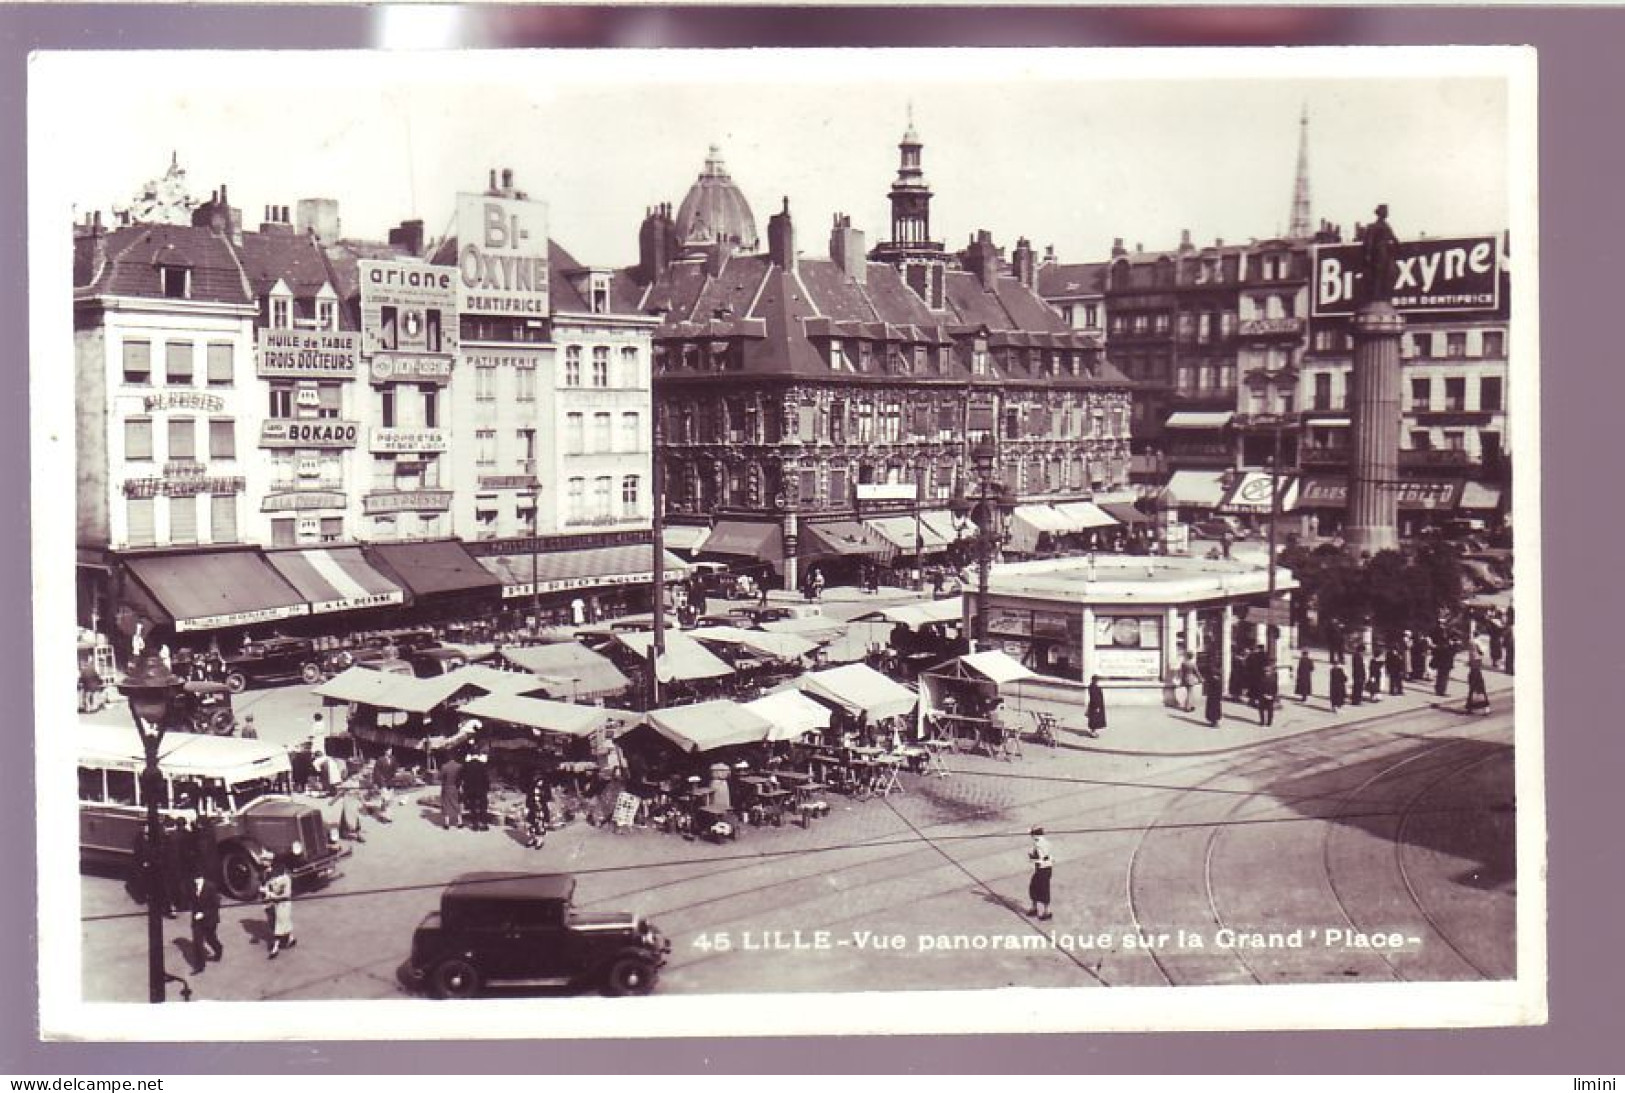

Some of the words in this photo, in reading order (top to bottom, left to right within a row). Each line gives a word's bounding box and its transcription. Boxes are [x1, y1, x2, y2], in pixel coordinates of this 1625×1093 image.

[461, 242, 548, 291] OXYNE
[370, 268, 450, 289] ariane
[466, 296, 542, 312] DENTIFRICE
[267, 336, 300, 348] HUILE
[303, 337, 318, 349] de
[321, 336, 353, 350] TABLE
[264, 351, 296, 369] TROIS
[297, 351, 354, 371] DOCTEURS
[466, 356, 538, 368] PATISSERIE
[289, 424, 356, 440] BOKADO
